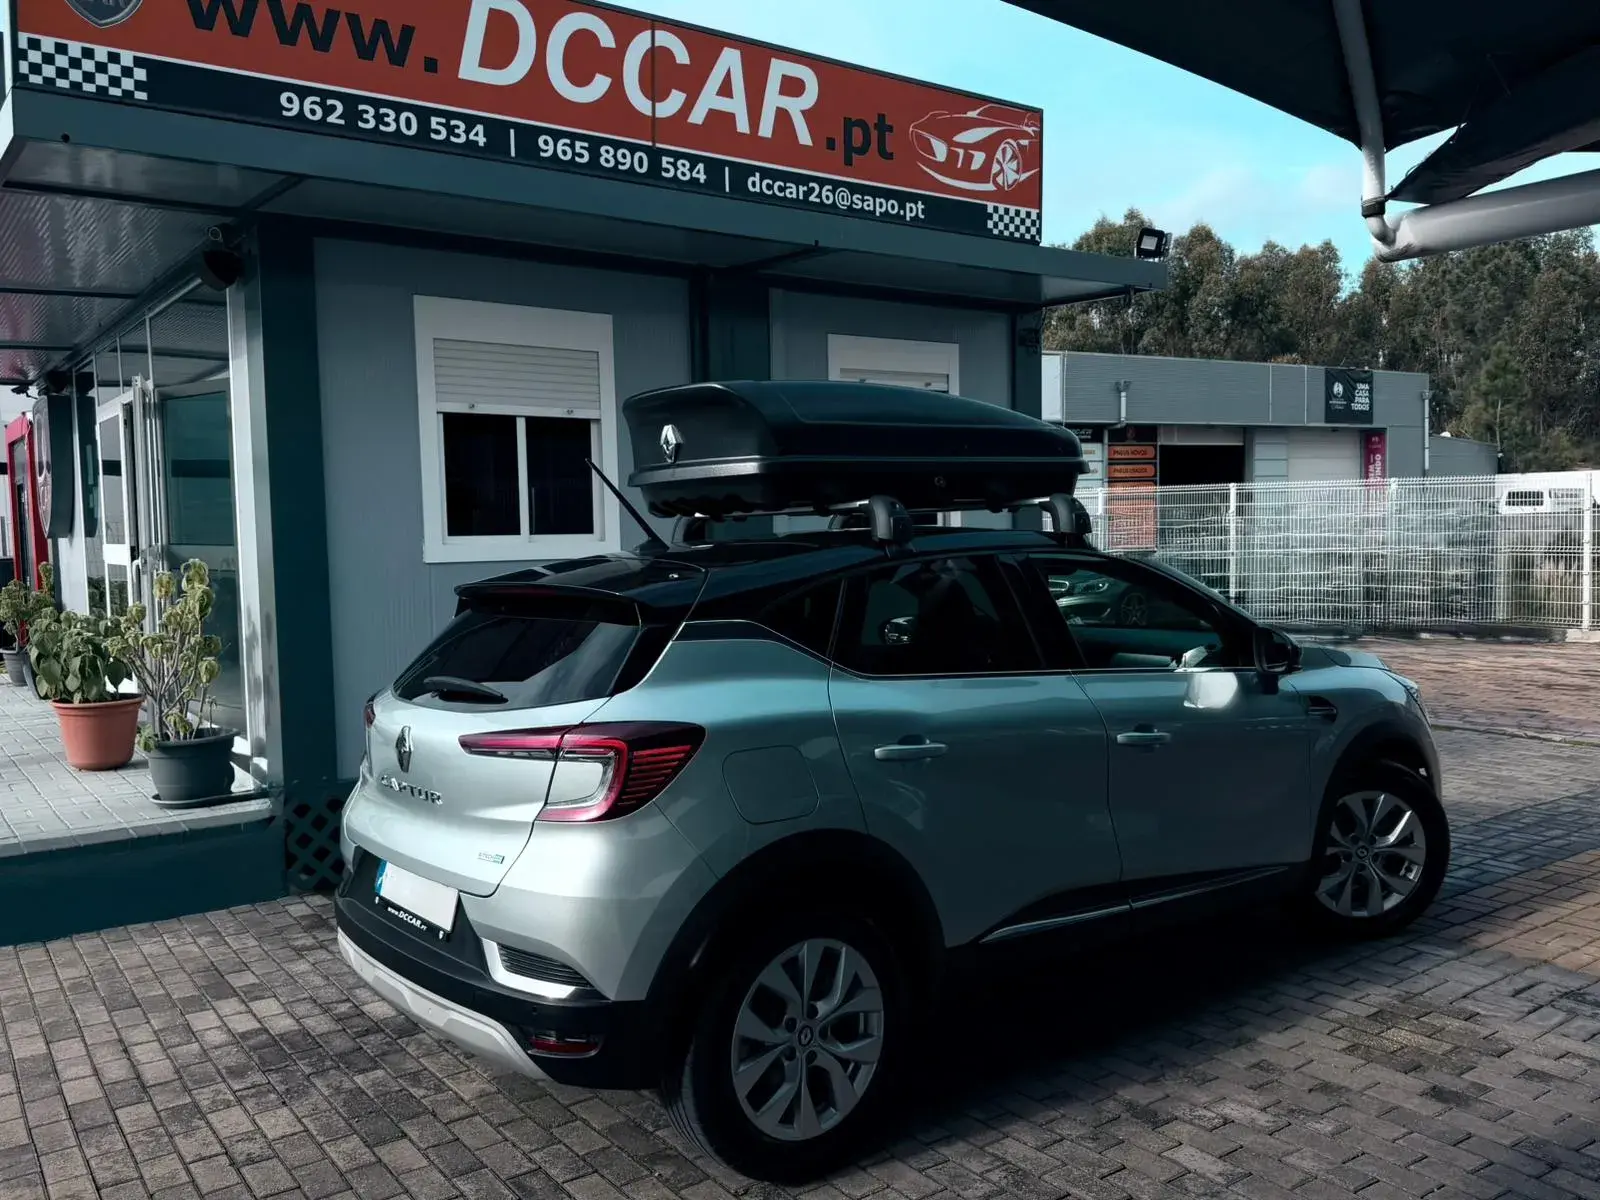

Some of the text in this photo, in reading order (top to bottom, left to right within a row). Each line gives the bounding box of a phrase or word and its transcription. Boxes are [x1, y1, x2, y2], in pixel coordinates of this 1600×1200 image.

[279, 91, 926, 221] 962 330 534 965 890 584 dccar26@sapo.pt
[1354, 389, 1370, 397] CASA
[1354, 396, 1370, 404] PARA
[1350, 403, 1370, 411] TODOS
[380, 774, 443, 806] CAPTUR
